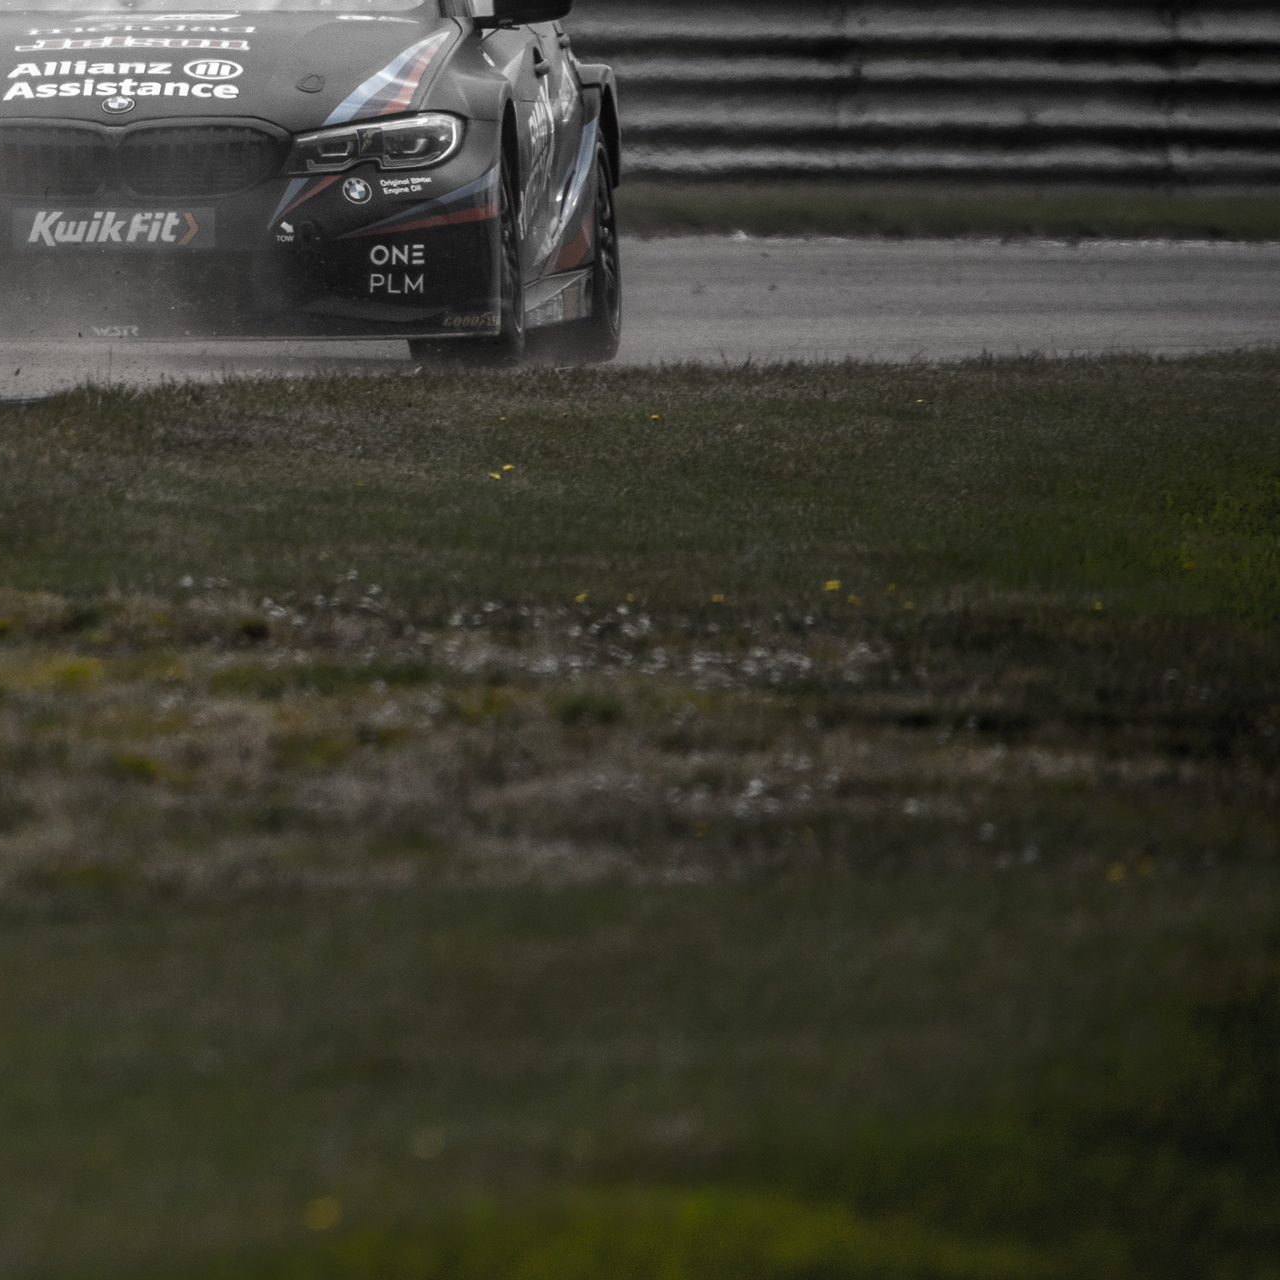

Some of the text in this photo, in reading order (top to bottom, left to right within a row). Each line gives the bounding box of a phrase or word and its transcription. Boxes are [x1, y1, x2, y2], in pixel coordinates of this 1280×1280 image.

[6, 60, 173, 79] Allianz
[2, 78, 240, 101] Assistance
[380, 177, 410, 187] Original
[410, 176, 433, 184] BMW
[383, 186, 410, 195] Engine
[275, 234, 295, 243] TOW
[369, 243, 426, 266] ONE
[369, 272, 425, 294] PLM
